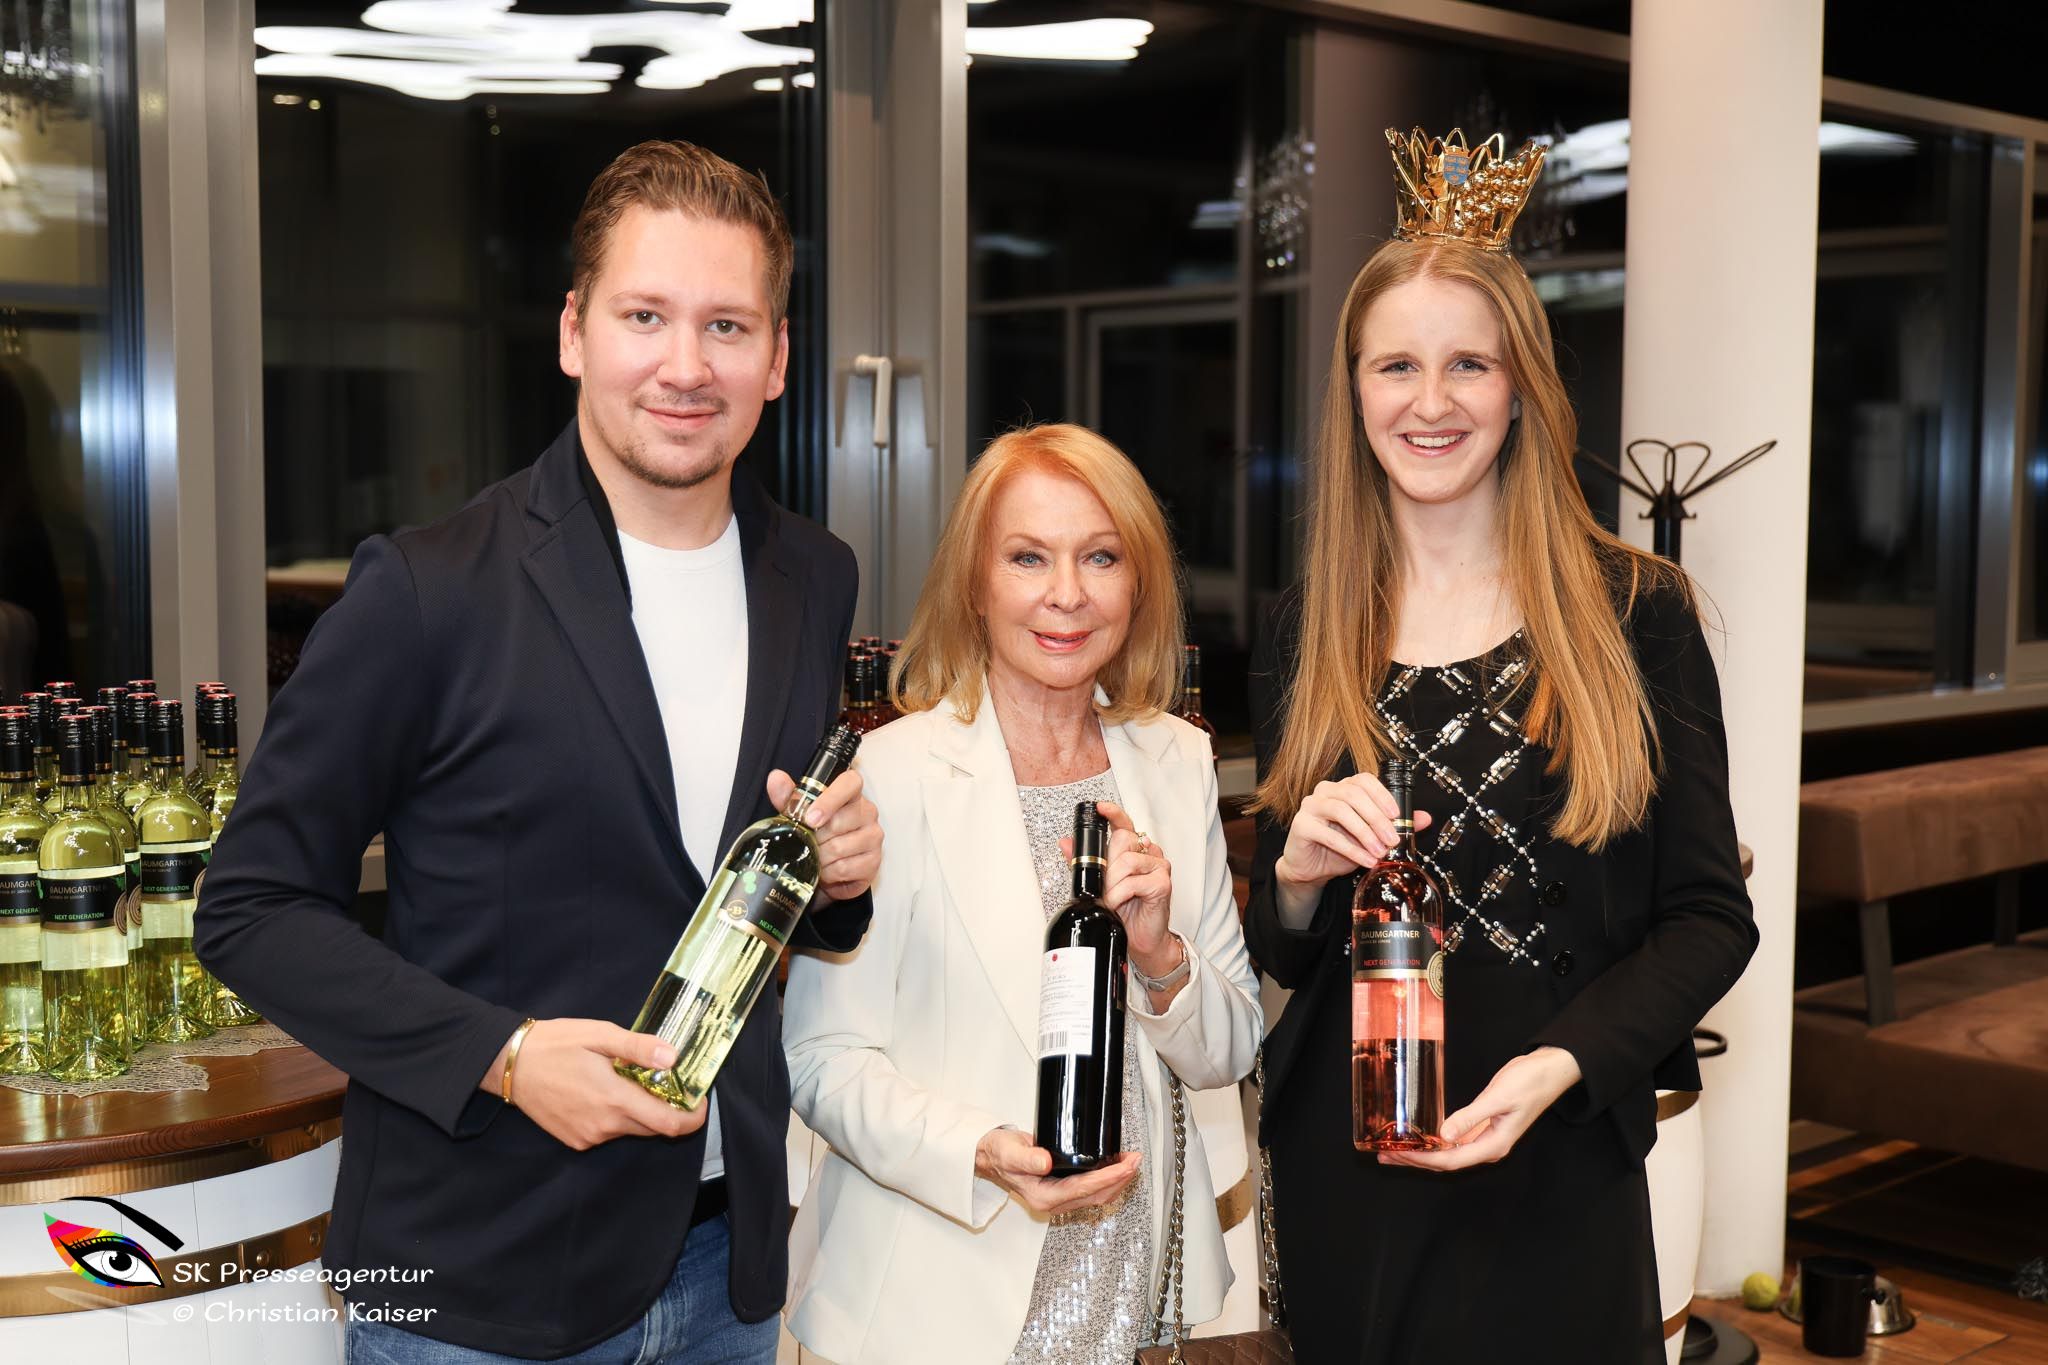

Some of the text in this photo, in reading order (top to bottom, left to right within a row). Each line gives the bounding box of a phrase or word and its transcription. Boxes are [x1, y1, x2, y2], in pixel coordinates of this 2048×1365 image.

[49, 884, 108, 895] BAUMGARTNER
[68, 912, 105, 920] GENERATION
[1361, 930, 1420, 939] BAUMGARTNER
